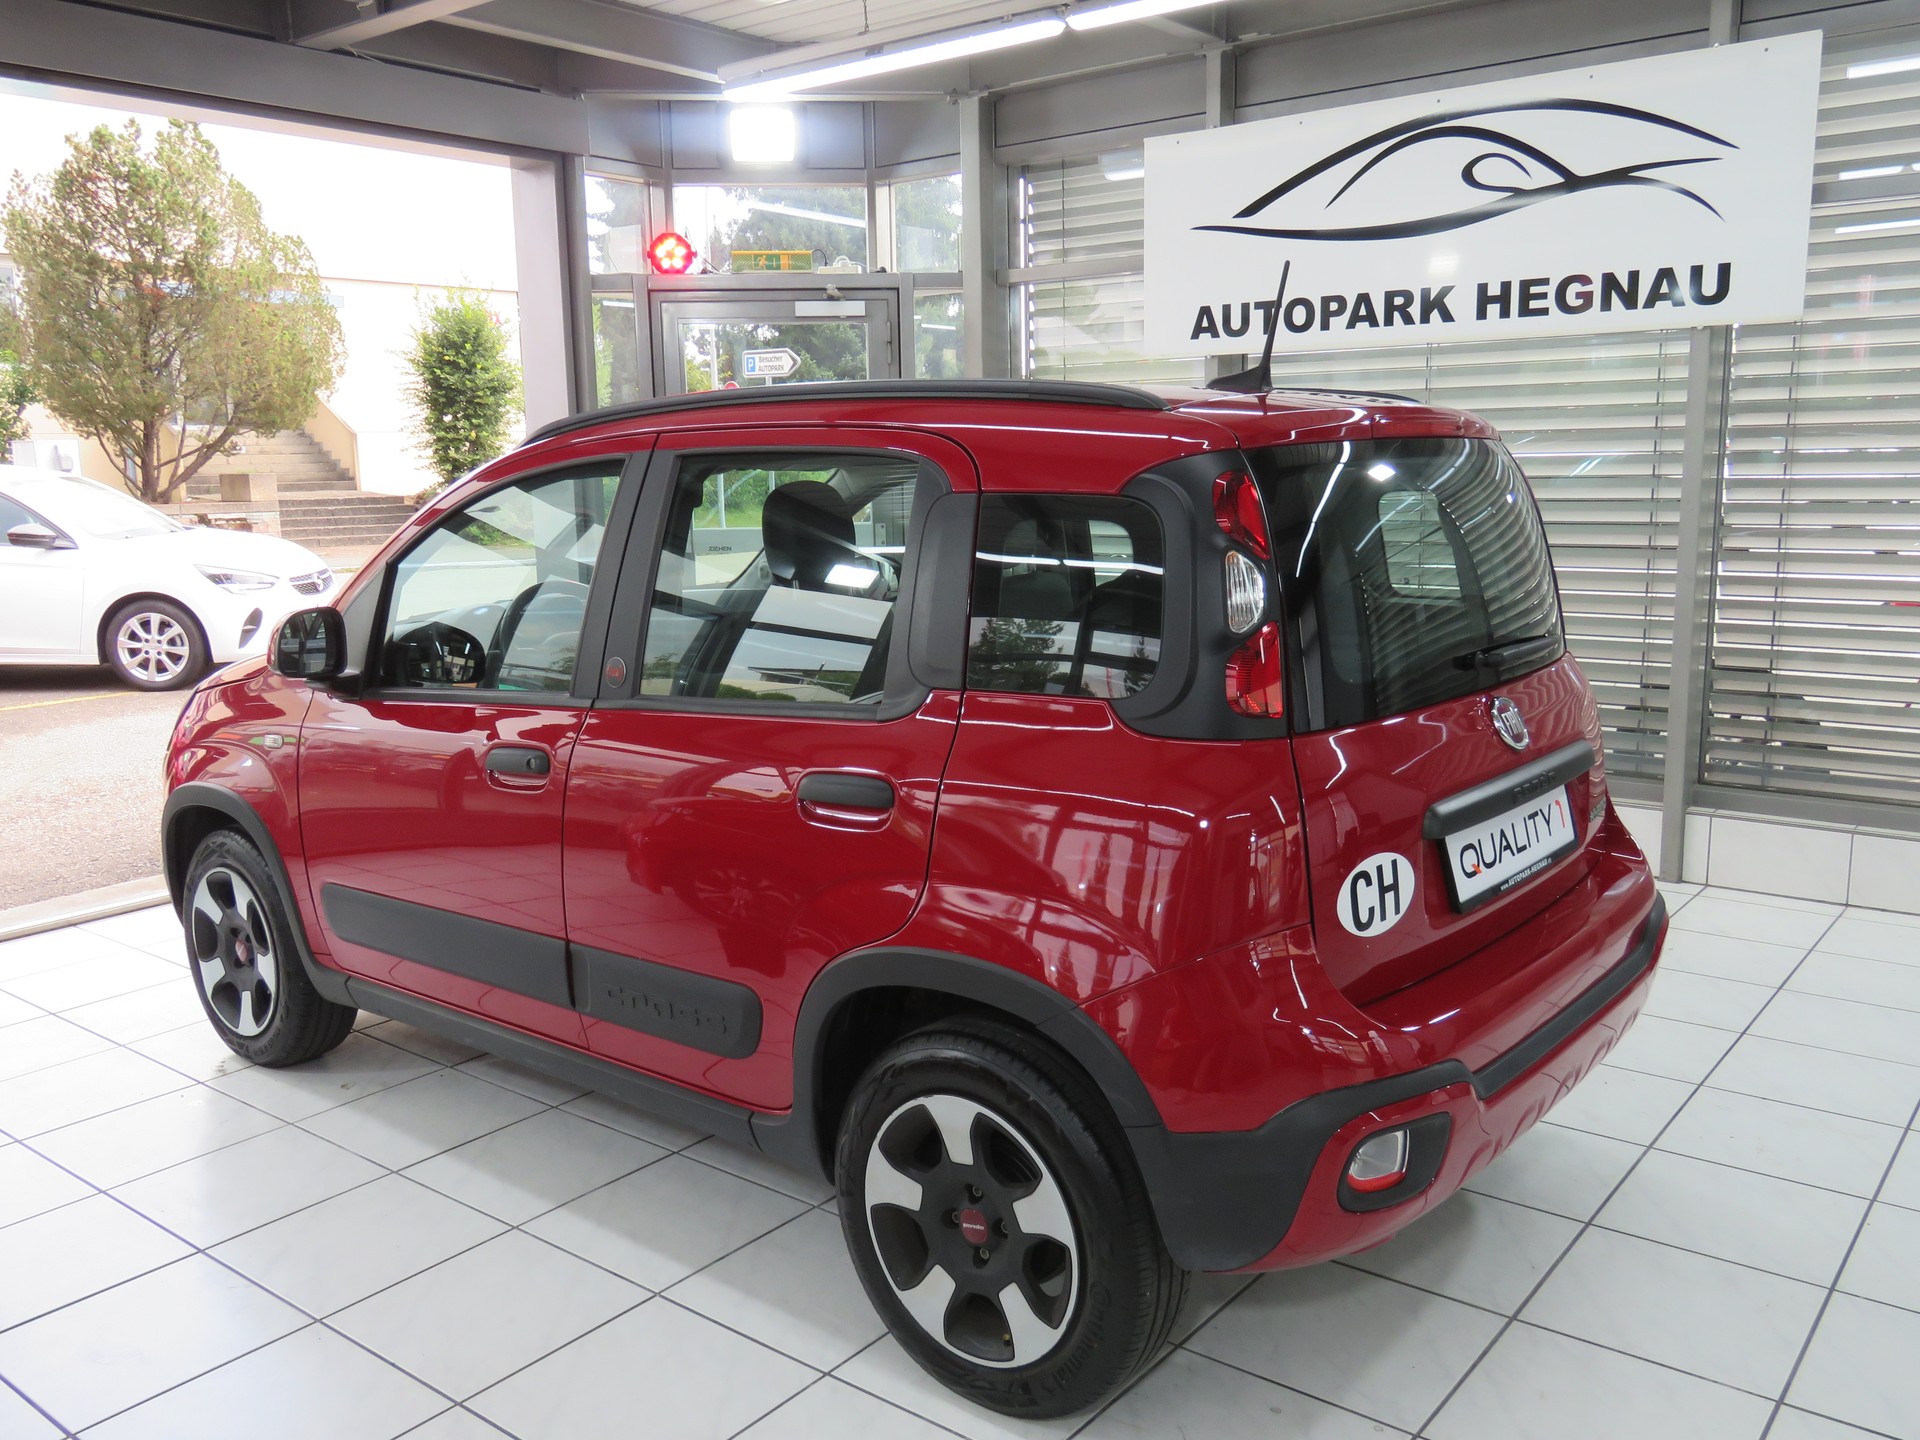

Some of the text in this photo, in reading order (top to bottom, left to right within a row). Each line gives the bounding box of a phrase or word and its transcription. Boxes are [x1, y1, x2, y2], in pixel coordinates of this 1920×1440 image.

[1190, 262, 1732, 340] AUTOPARK HEGNAU
[758, 355, 783, 363] Besucher
[758, 364, 785, 372] AUTOPARK
[1460, 804, 1552, 879] QUALITY
[1350, 858, 1401, 932] CH
